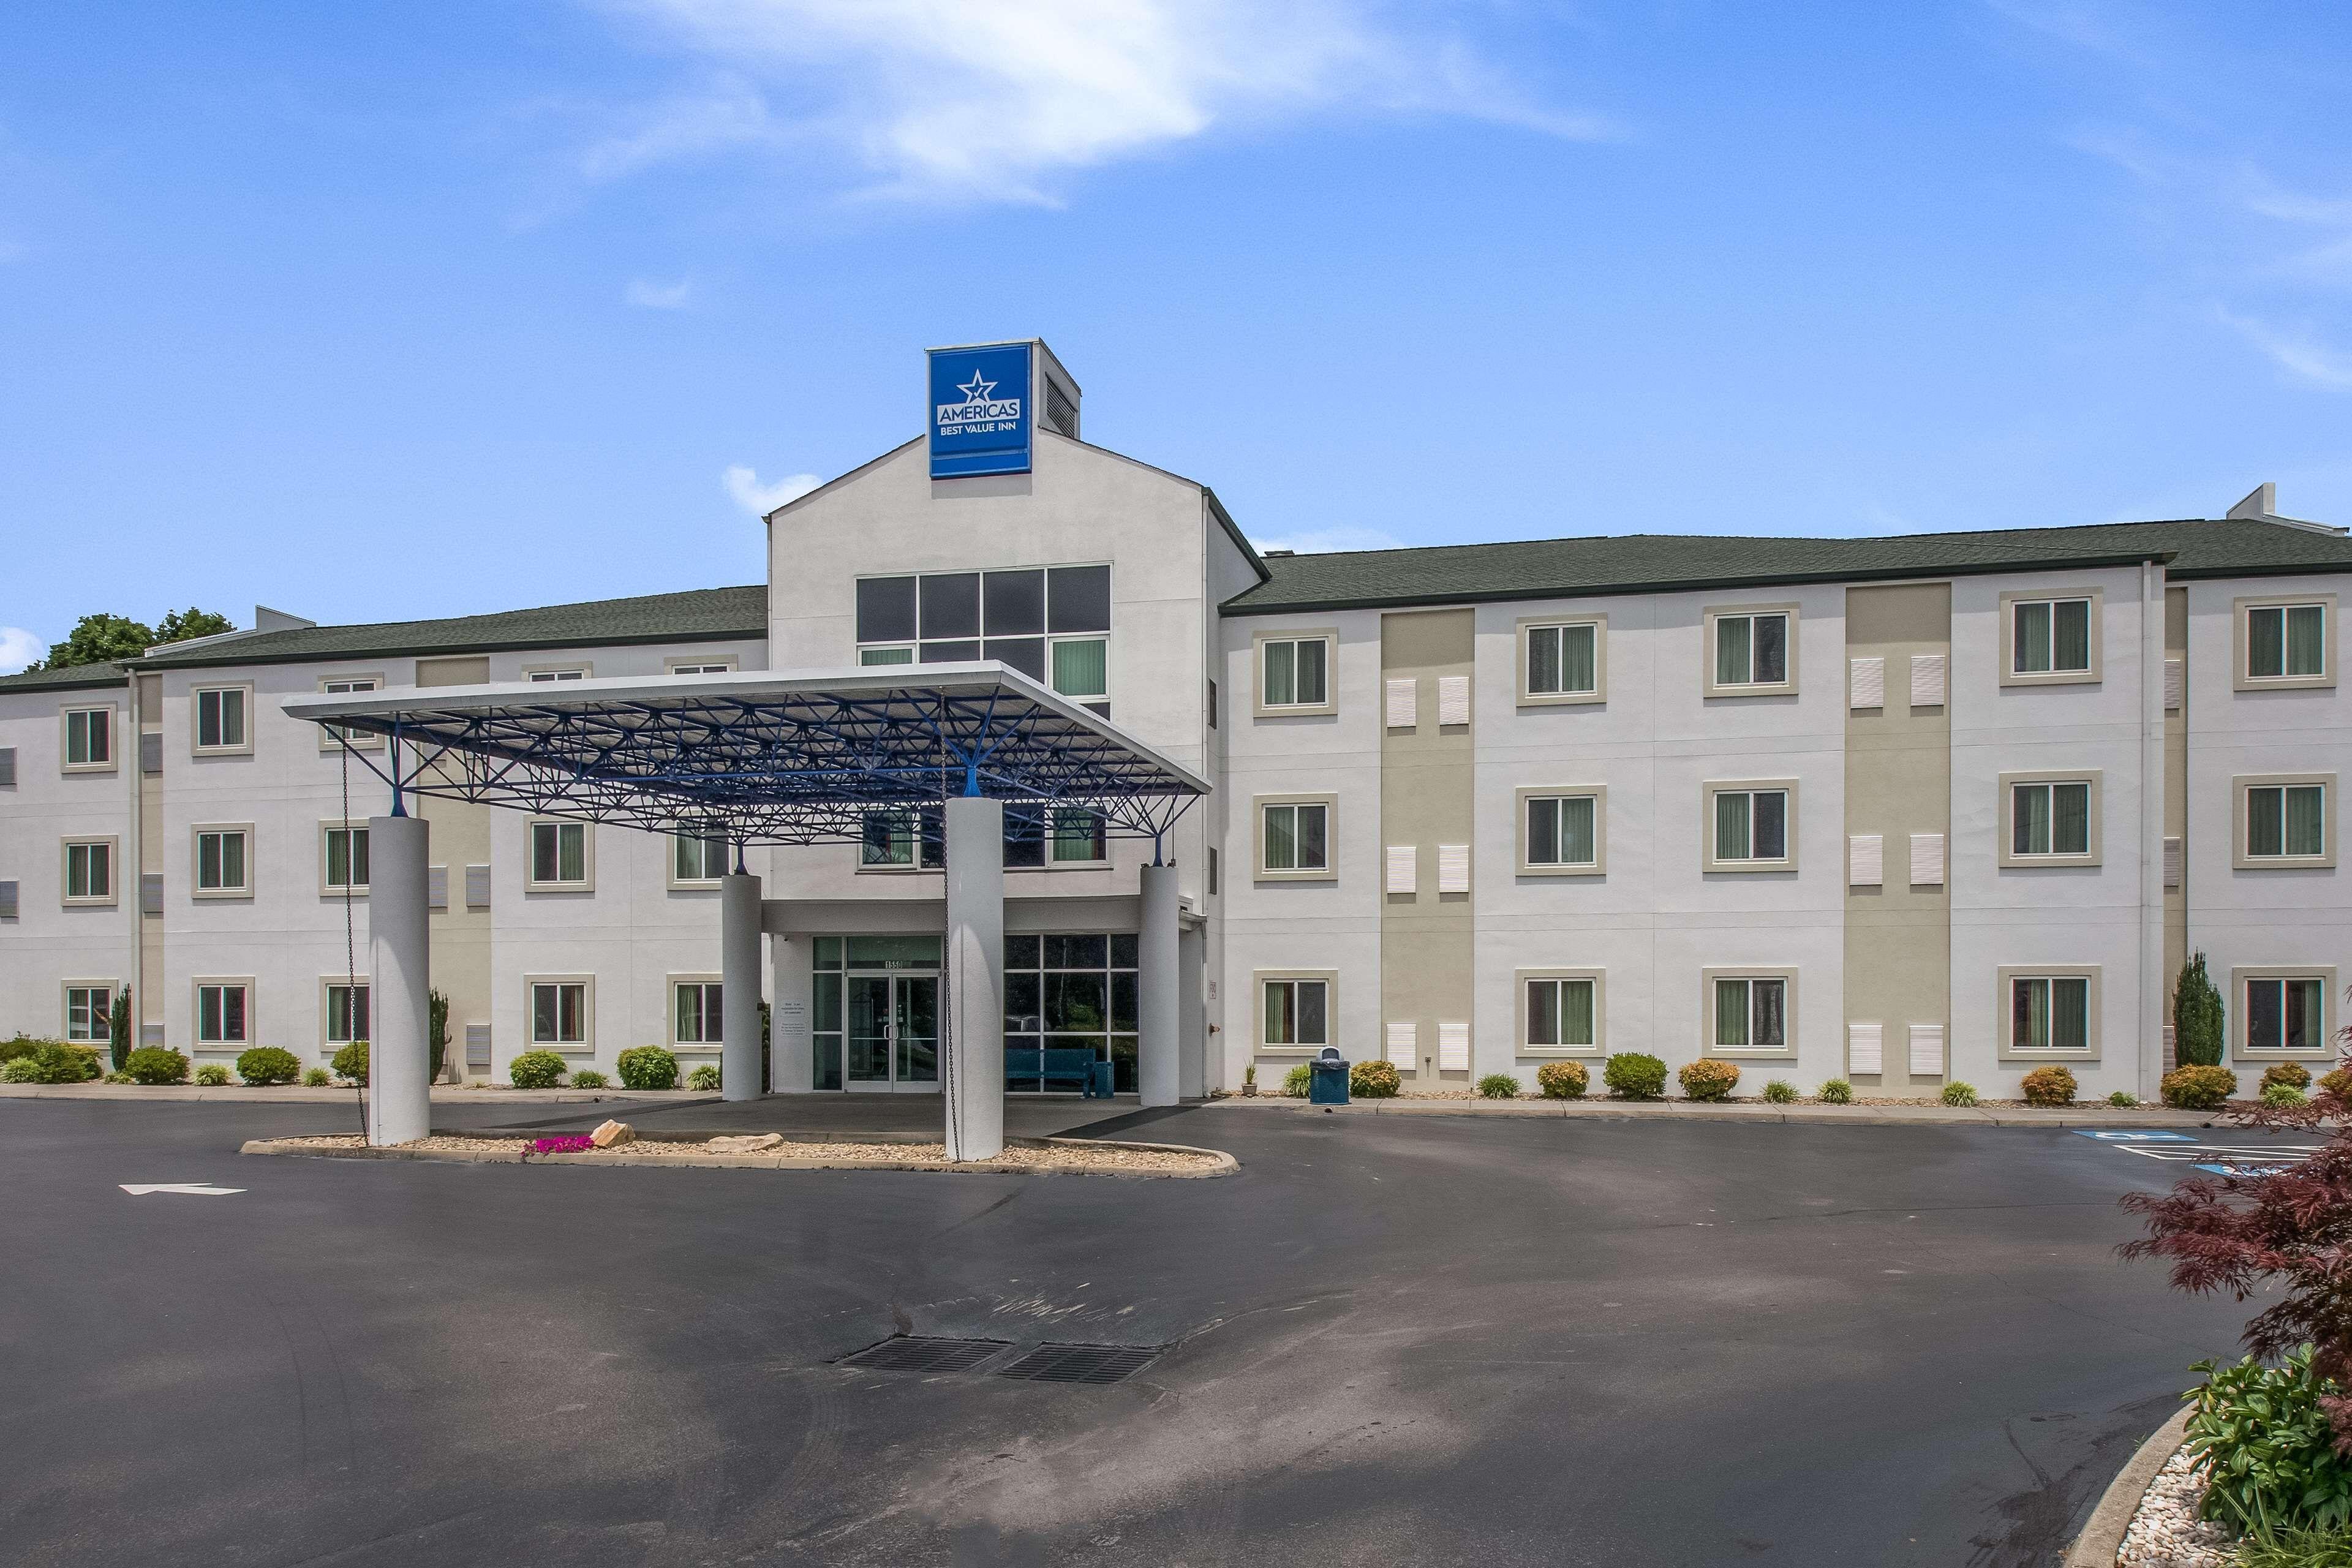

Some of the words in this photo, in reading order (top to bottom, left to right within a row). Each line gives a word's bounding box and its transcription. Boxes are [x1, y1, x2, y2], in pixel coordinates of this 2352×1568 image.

[940, 402, 1018, 423] AMERICAS
[941, 426, 963, 436] BEST
[965, 423, 995, 434] VALUE
[998, 421, 1016, 431] INN
